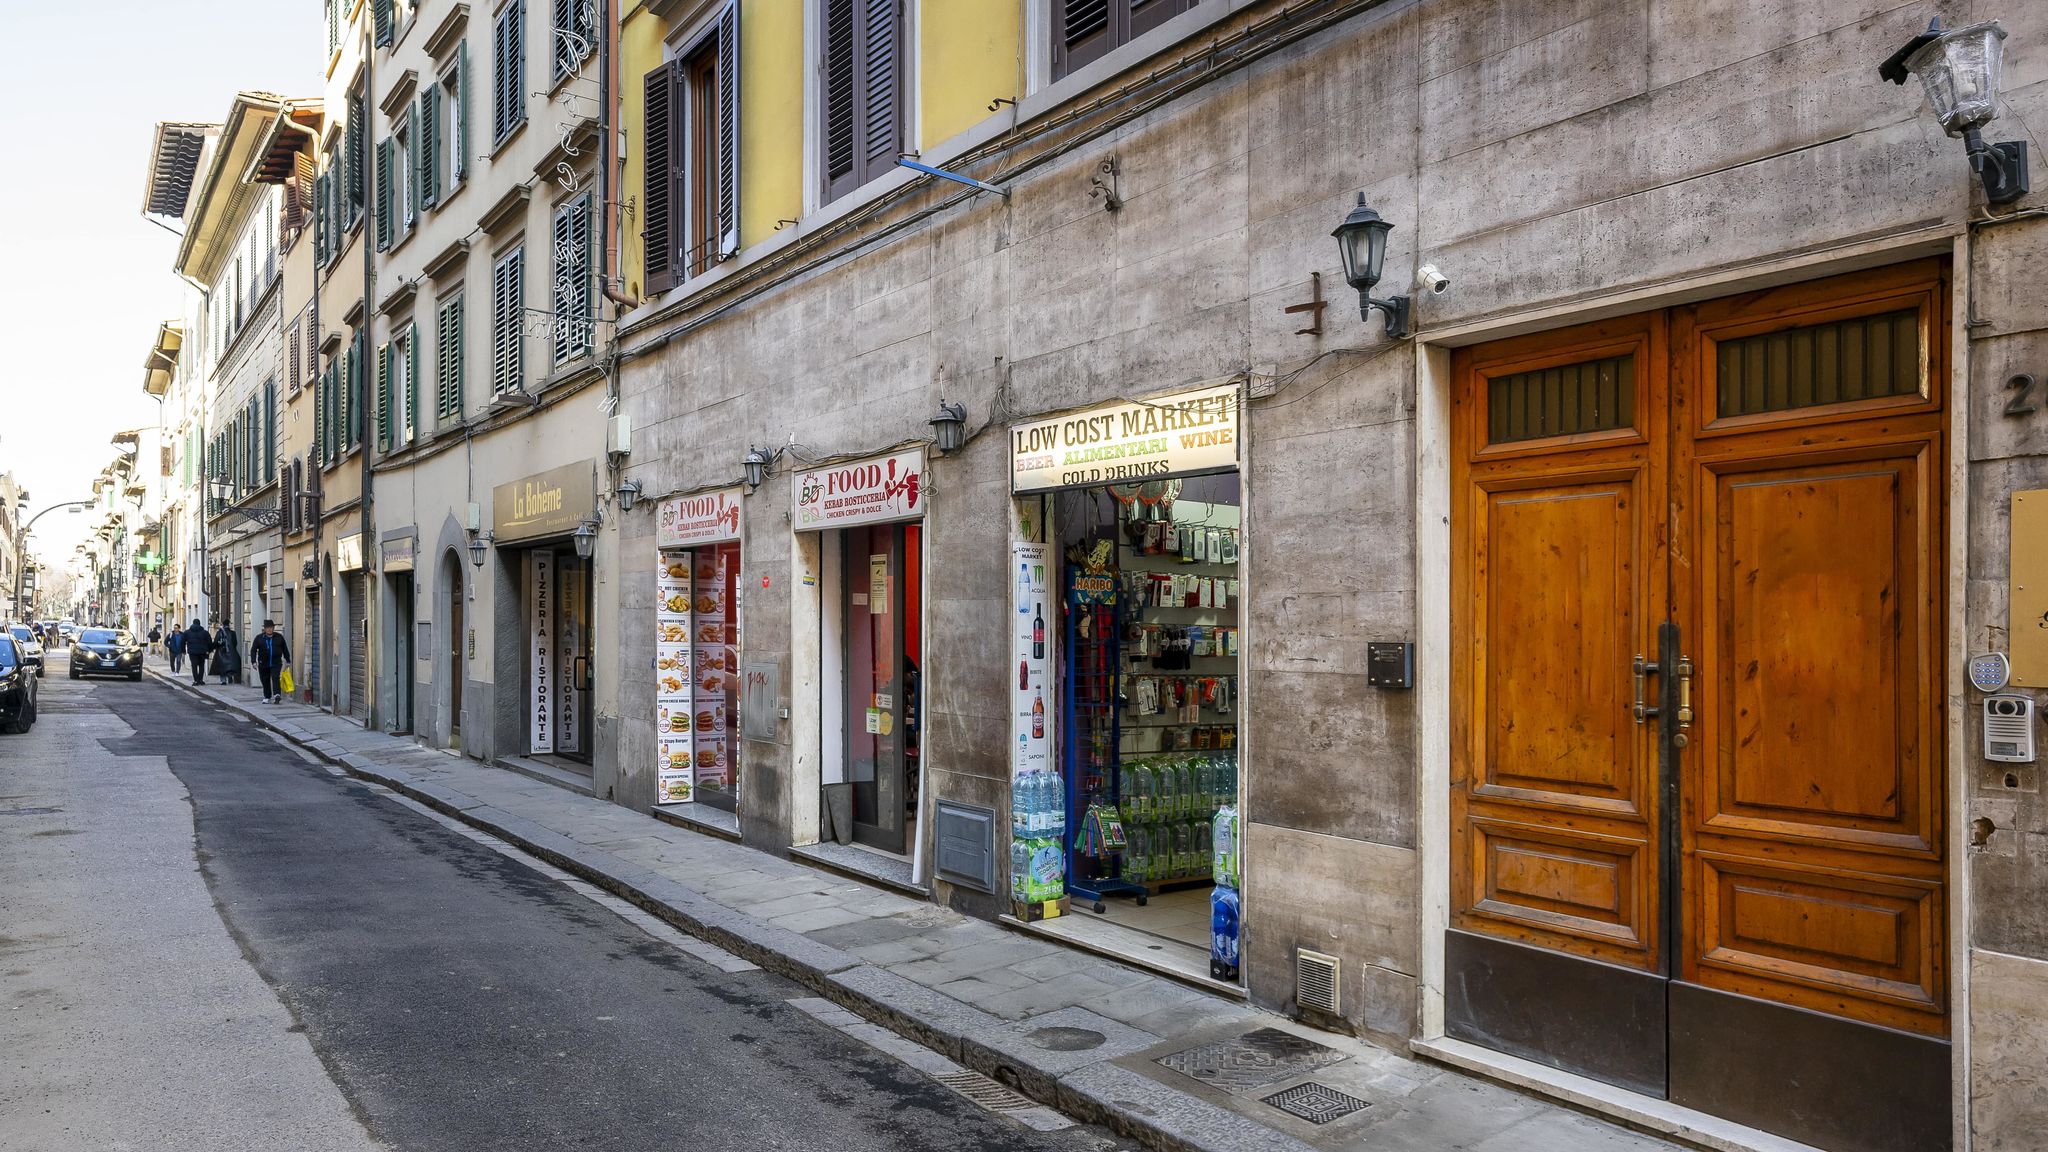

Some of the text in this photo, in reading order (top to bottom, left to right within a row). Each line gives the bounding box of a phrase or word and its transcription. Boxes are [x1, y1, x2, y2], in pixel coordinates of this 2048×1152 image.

[2003, 373, 2048, 419] 2
[1017, 393, 1233, 455] LOW COST MARKET
[1016, 427, 1233, 473] BEER ALIMENTARI WINE
[826, 464, 882, 495] FOOD
[1062, 459, 1170, 485] COLD DRINKS
[513, 480, 562, 520] La Bohème
[680, 497, 715, 520] FOOD
[824, 491, 887, 510] KEBAB ROSTICCERIA
[826, 510, 845, 519] CHICKEN
[845, 508, 860, 517] CRISPY
[866, 505, 882, 514] DOLCE
[677, 519, 717, 531] KEBAB ROSTICCERIA
[1075, 576, 1114, 592] HARIBO
[538, 562, 546, 637] PIZZERIA
[537, 647, 547, 741] RISTORANTE
[1043, 883, 1063, 896] ZERO
